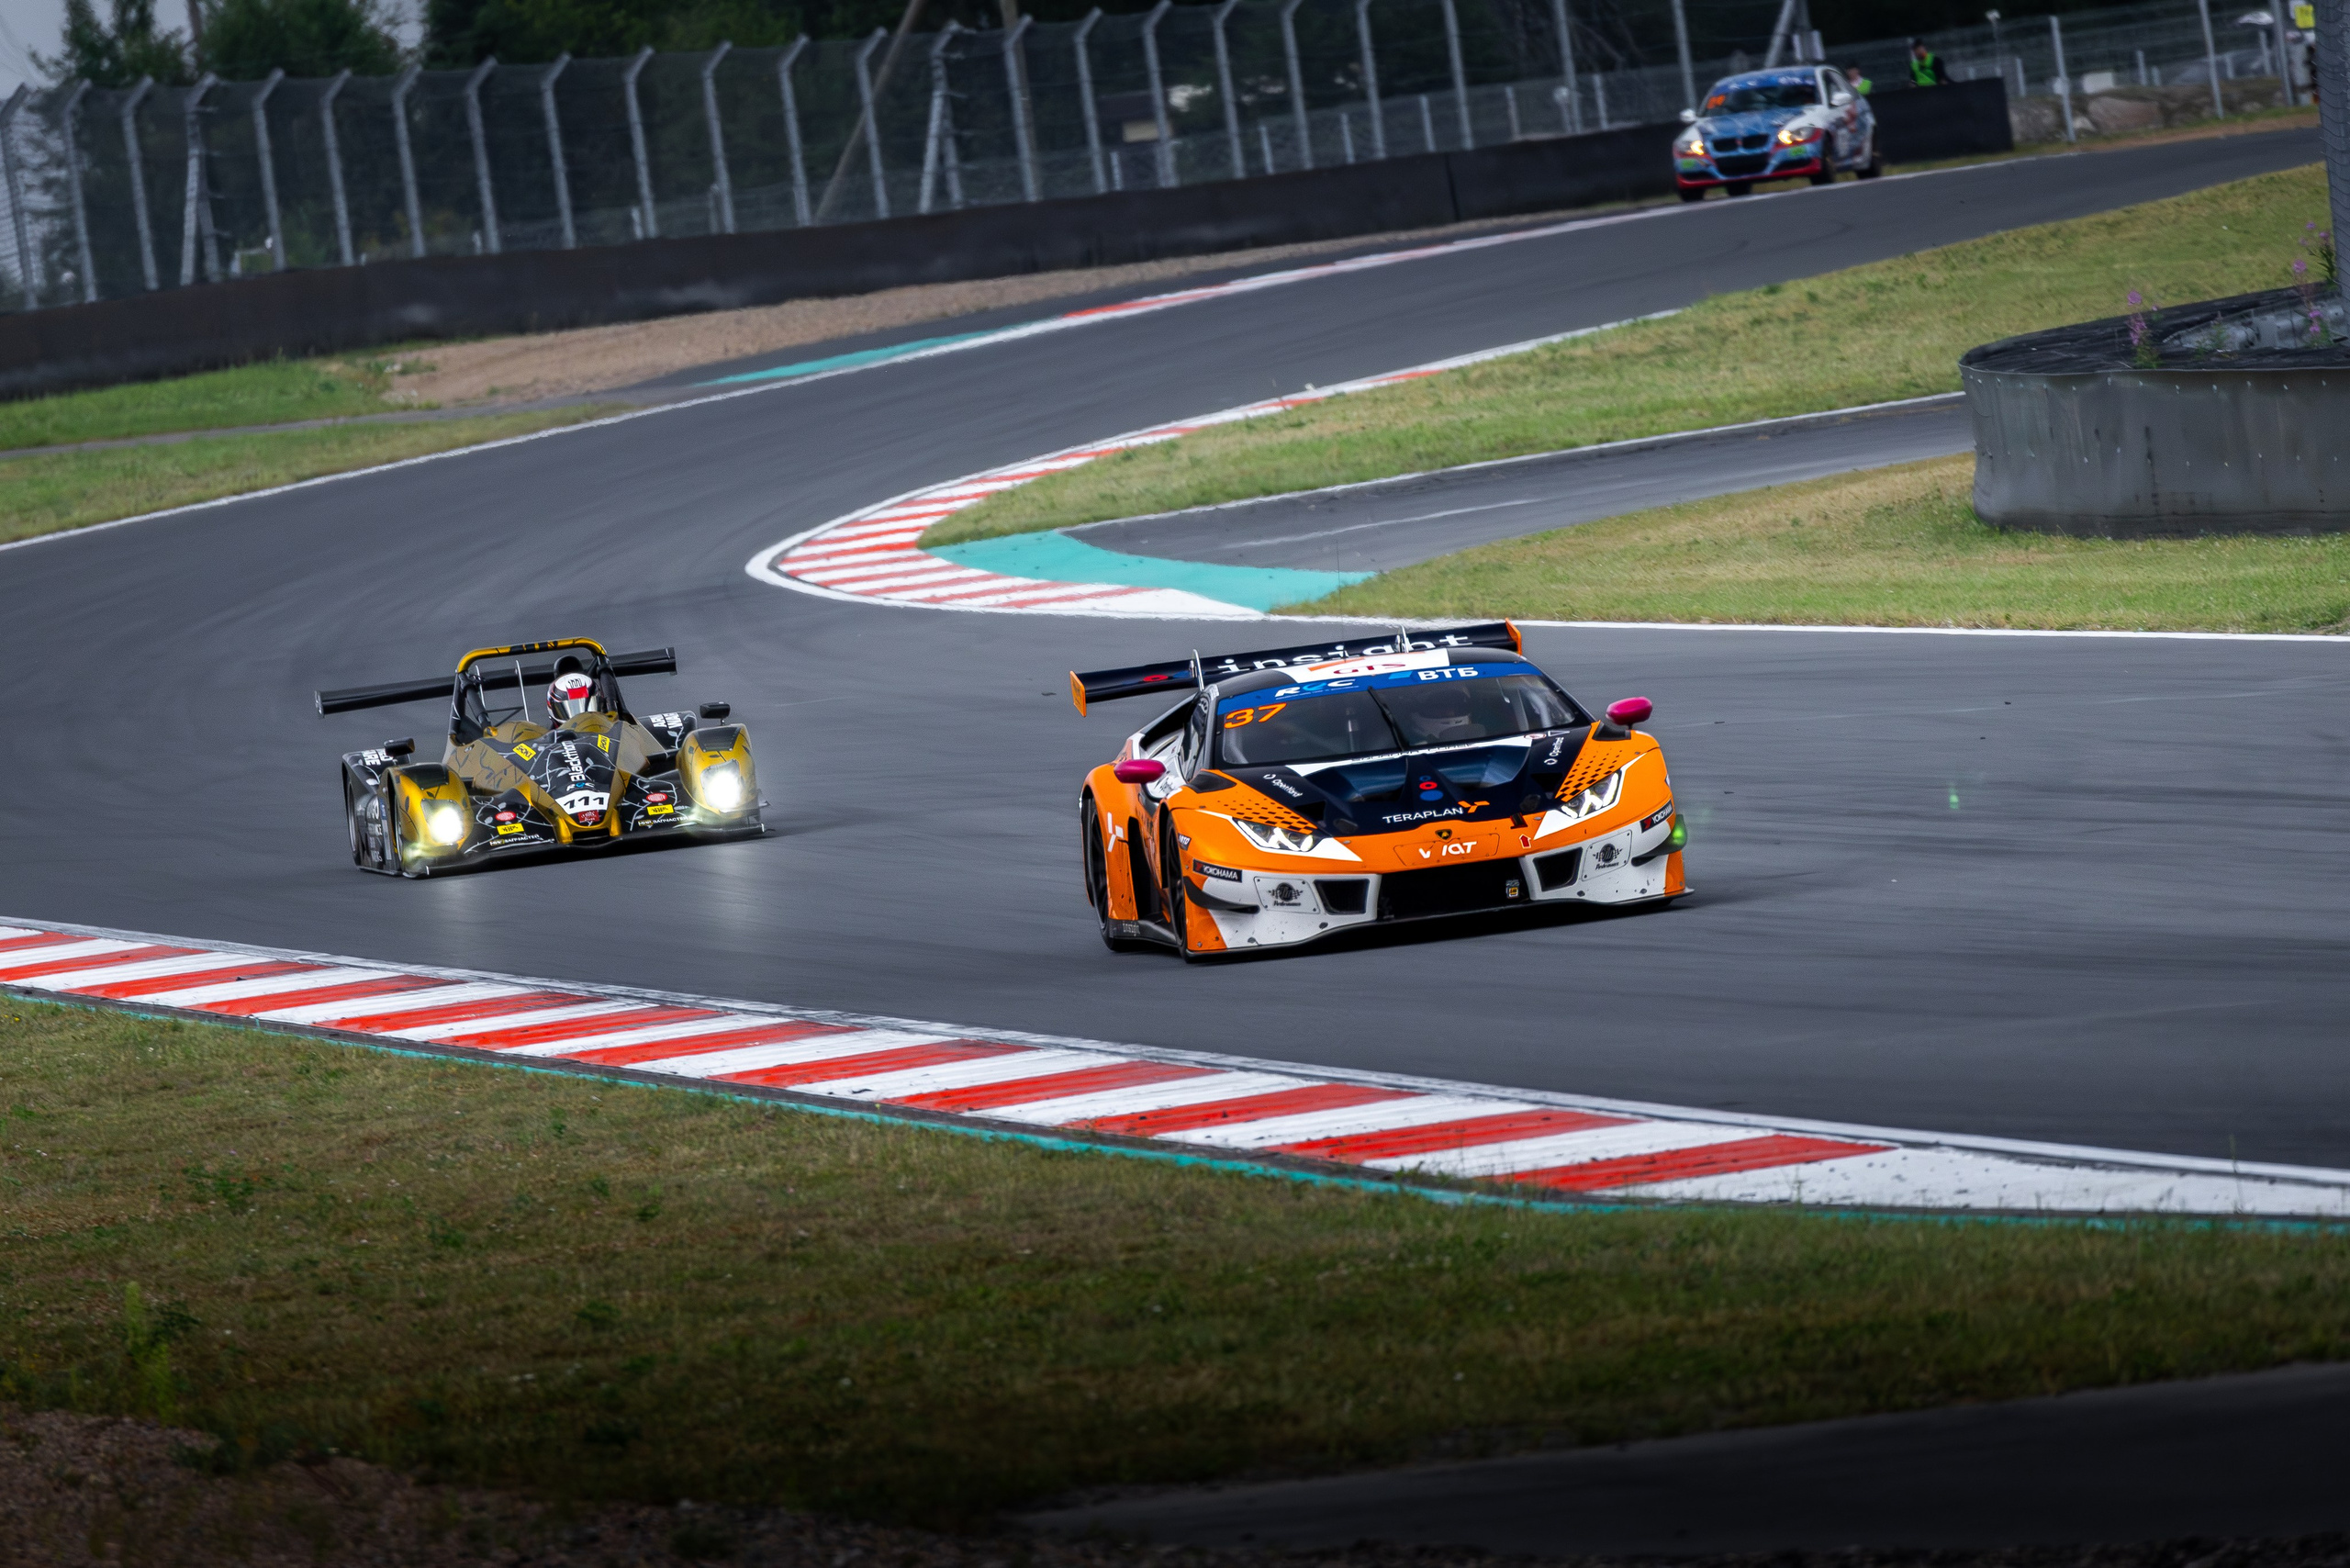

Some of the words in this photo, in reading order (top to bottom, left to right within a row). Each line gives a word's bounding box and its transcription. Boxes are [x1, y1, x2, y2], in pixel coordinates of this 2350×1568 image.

[1417, 666, 1479, 681] ВТБ
[1224, 702, 1287, 729] 37
[564, 796, 604, 809] 111
[1382, 806, 1464, 824] TERAPLAN
[1203, 864, 1238, 880] YOKOHAMA
